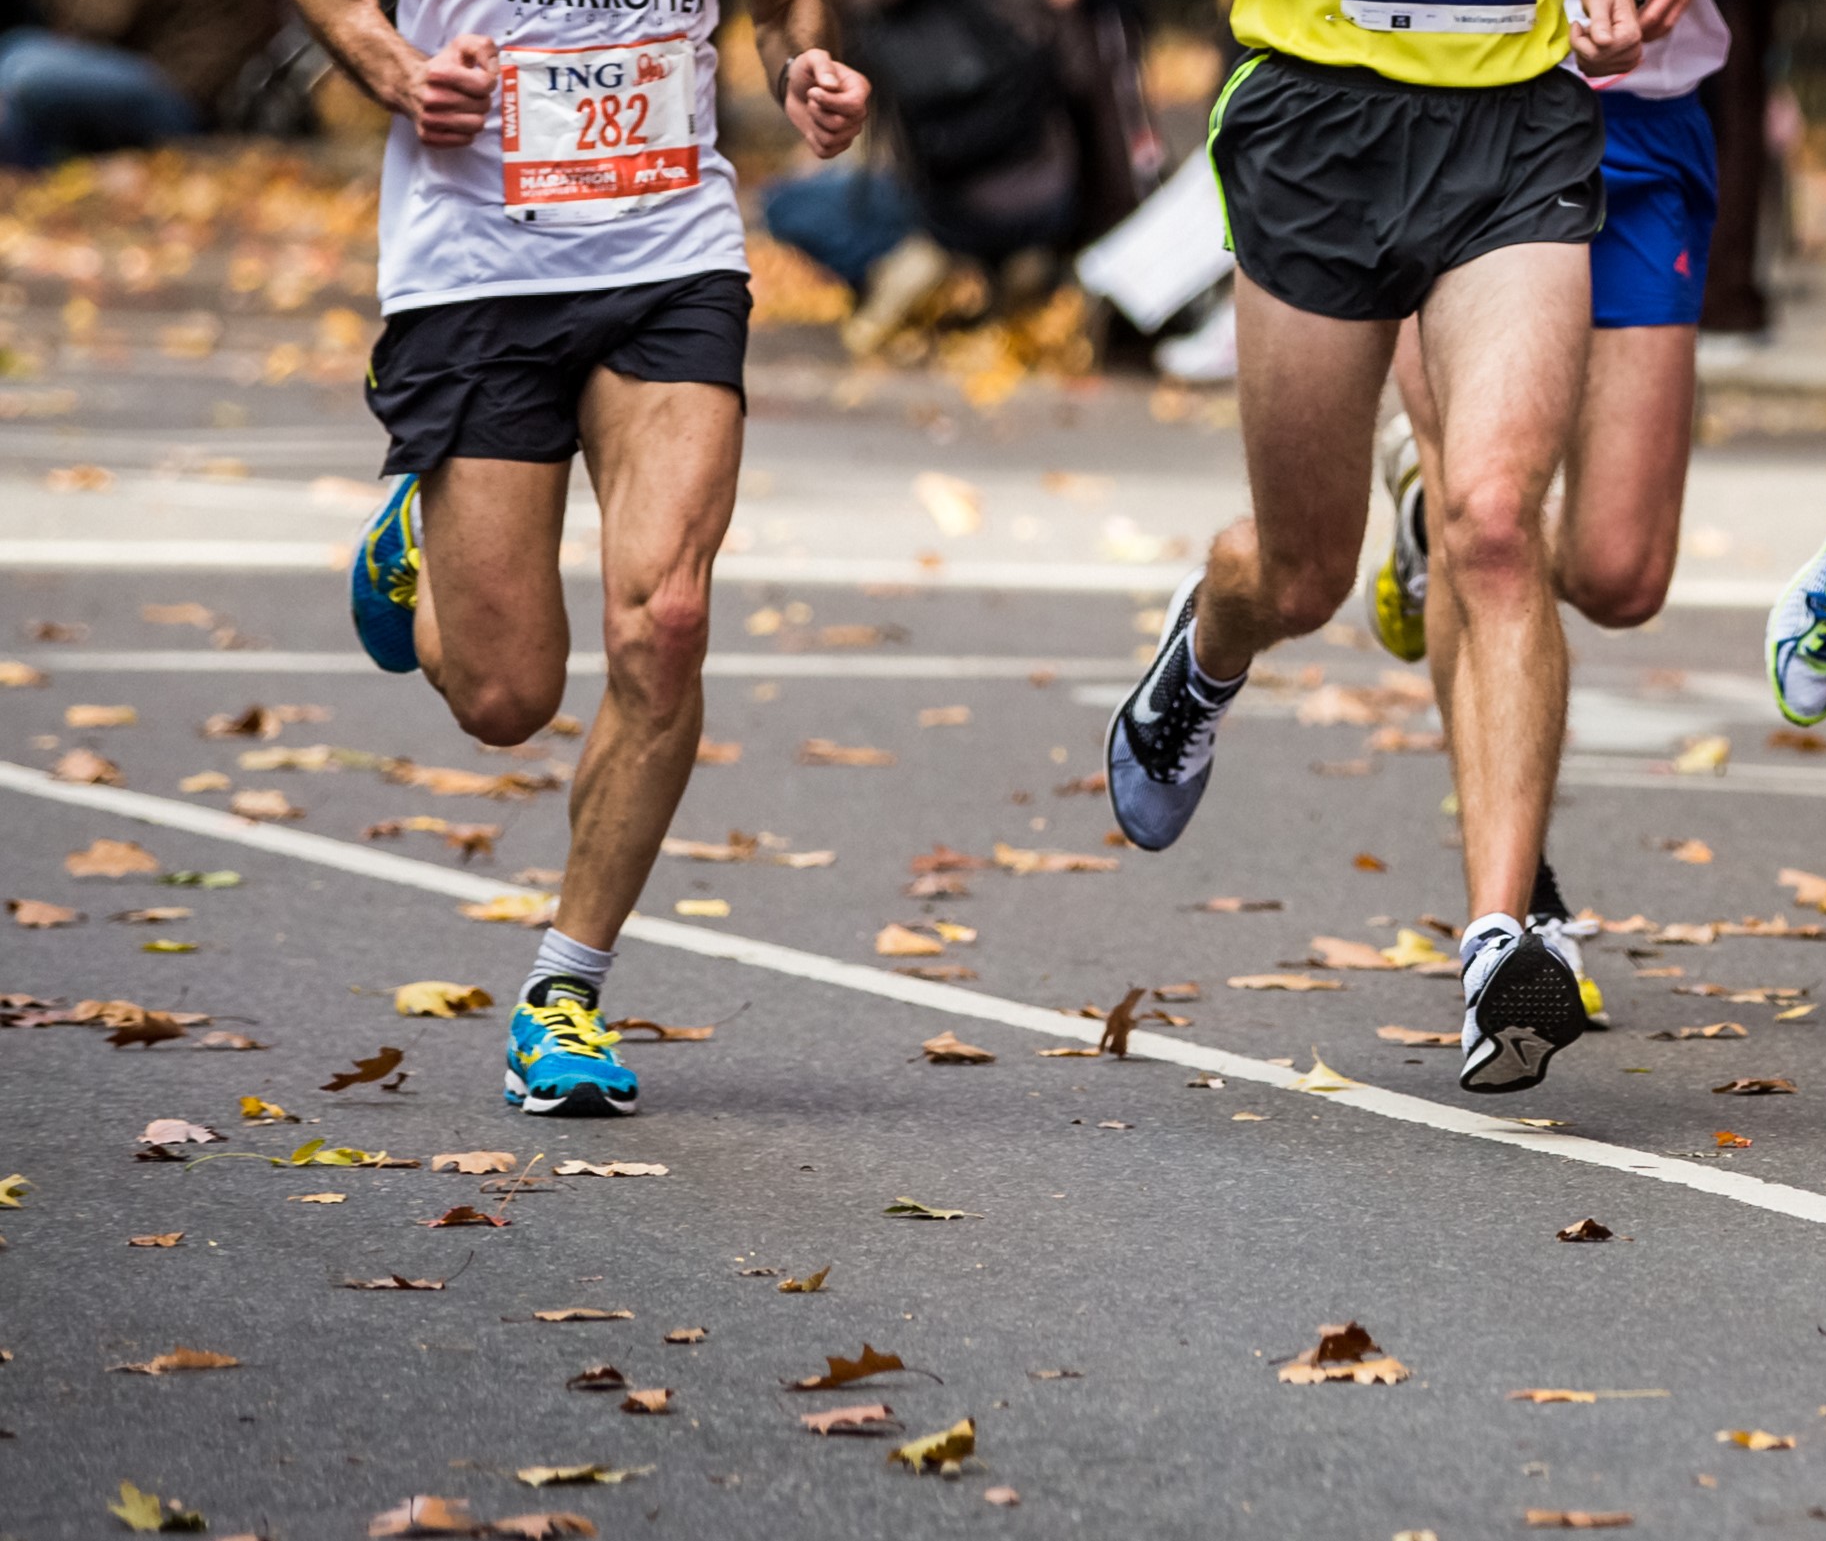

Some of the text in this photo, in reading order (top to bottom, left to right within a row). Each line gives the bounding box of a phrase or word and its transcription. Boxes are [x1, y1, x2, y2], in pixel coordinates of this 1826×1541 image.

[546, 63, 624, 92] ING
[503, 92, 518, 138] WAVE
[576, 93, 649, 150] 282
[520, 170, 617, 189] MARATHON
